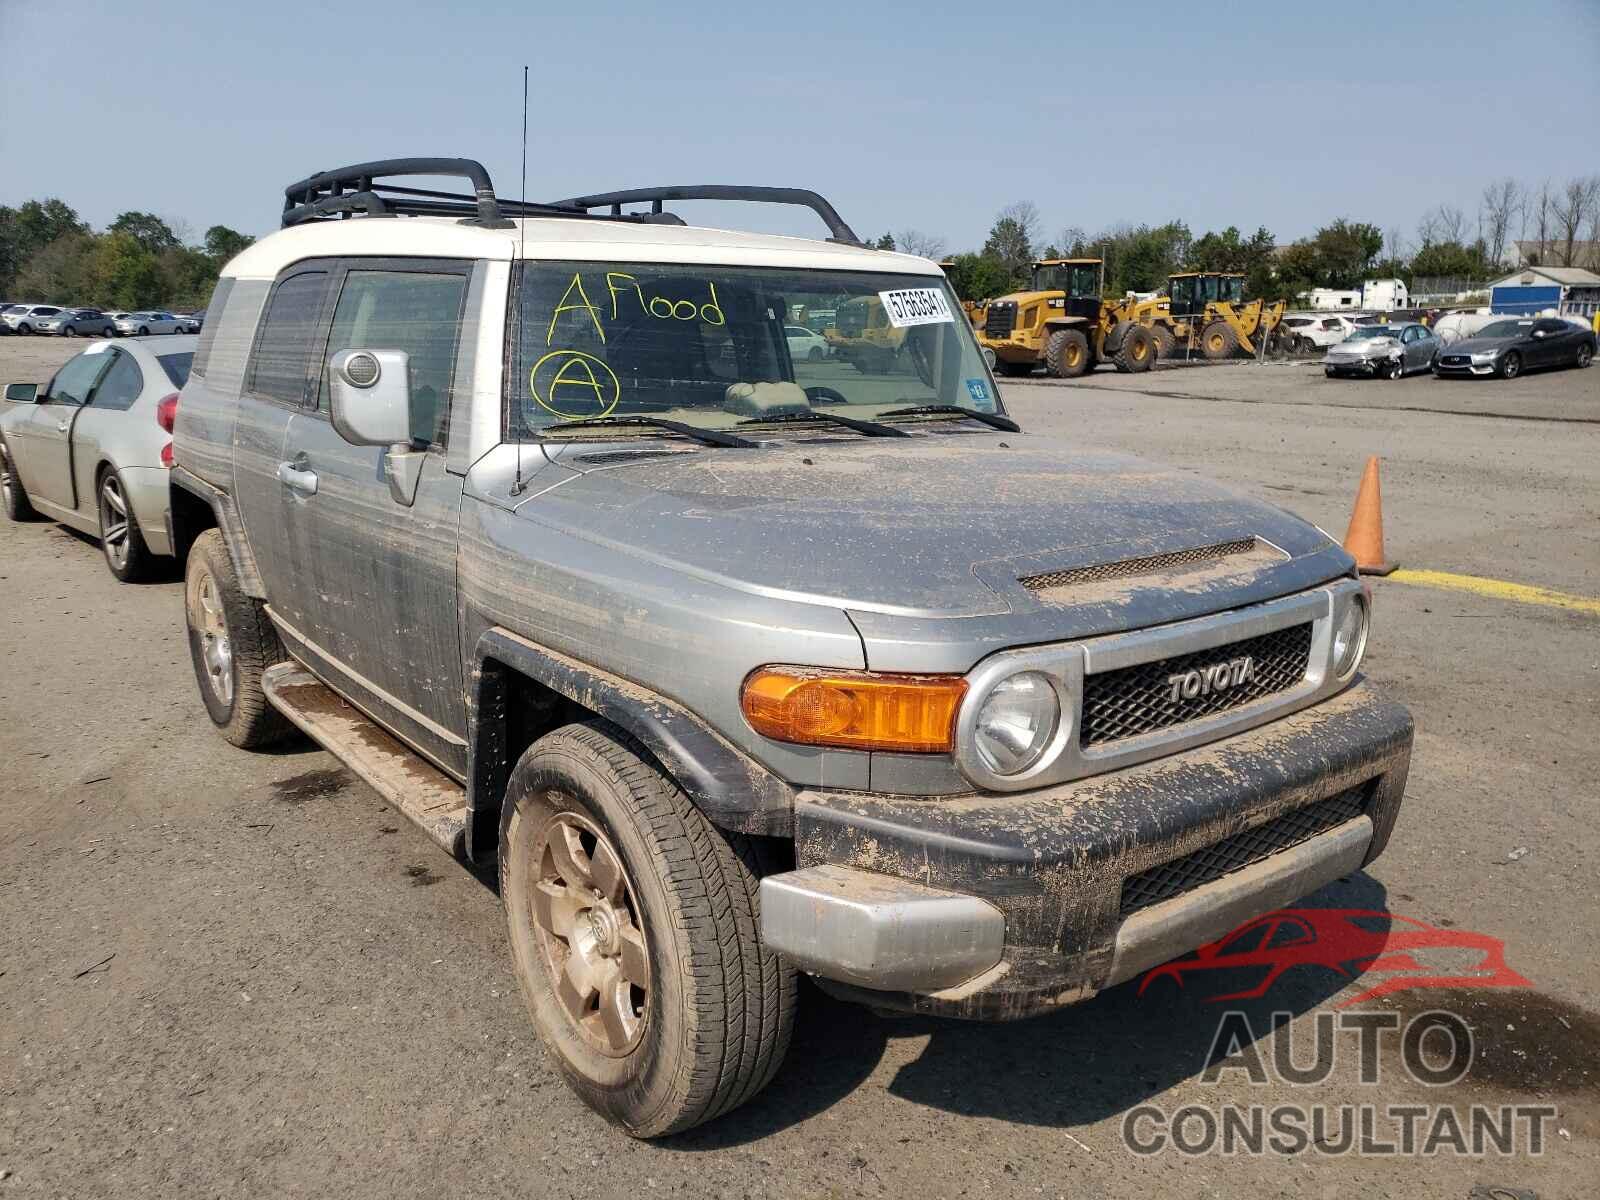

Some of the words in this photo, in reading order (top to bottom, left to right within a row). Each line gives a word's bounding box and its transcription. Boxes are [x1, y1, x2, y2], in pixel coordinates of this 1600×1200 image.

[547, 272, 605, 346] A
[606, 272, 726, 326] Flood
[889, 290, 944, 318] 57563541
[548, 356, 607, 410] A
[1168, 657, 1255, 702] TOYOTA
